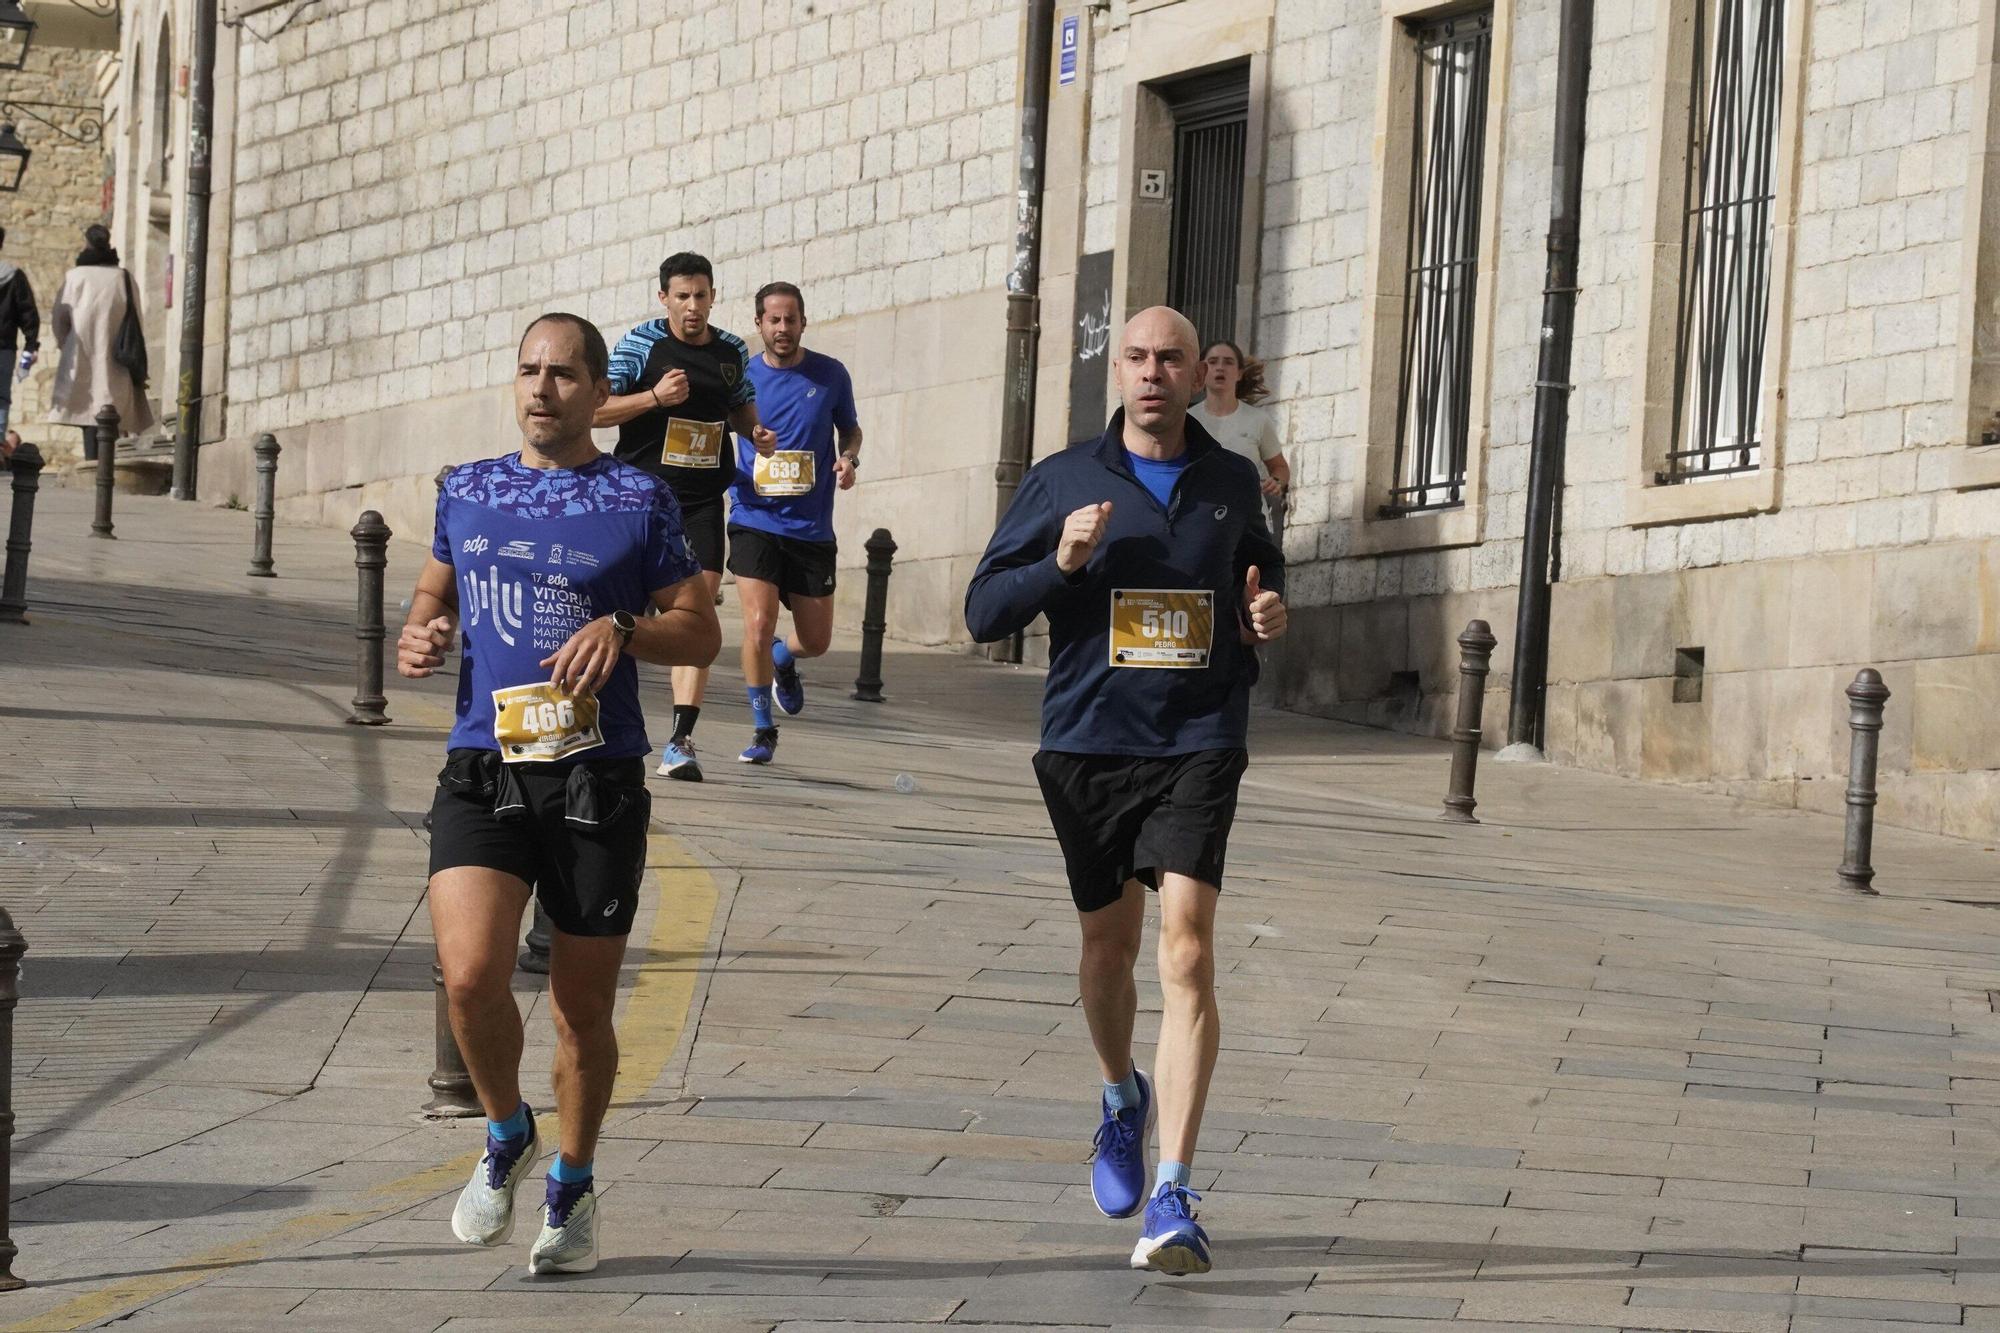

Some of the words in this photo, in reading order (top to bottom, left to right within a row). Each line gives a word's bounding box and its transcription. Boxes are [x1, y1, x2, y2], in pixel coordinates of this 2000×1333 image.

[1145, 174, 1160, 193] 5
[689, 433, 707, 450] 74
[769, 461, 800, 479] 638
[463, 535, 489, 556] edp
[547, 573, 569, 589] edp
[533, 586, 593, 607] VITORIA
[533, 601, 593, 620] GASTEIZ
[533, 614, 590, 629] MARATO
[1142, 609, 1189, 639] 510
[1154, 640, 1177, 648] PEDRO
[522, 700, 575, 734] 466
